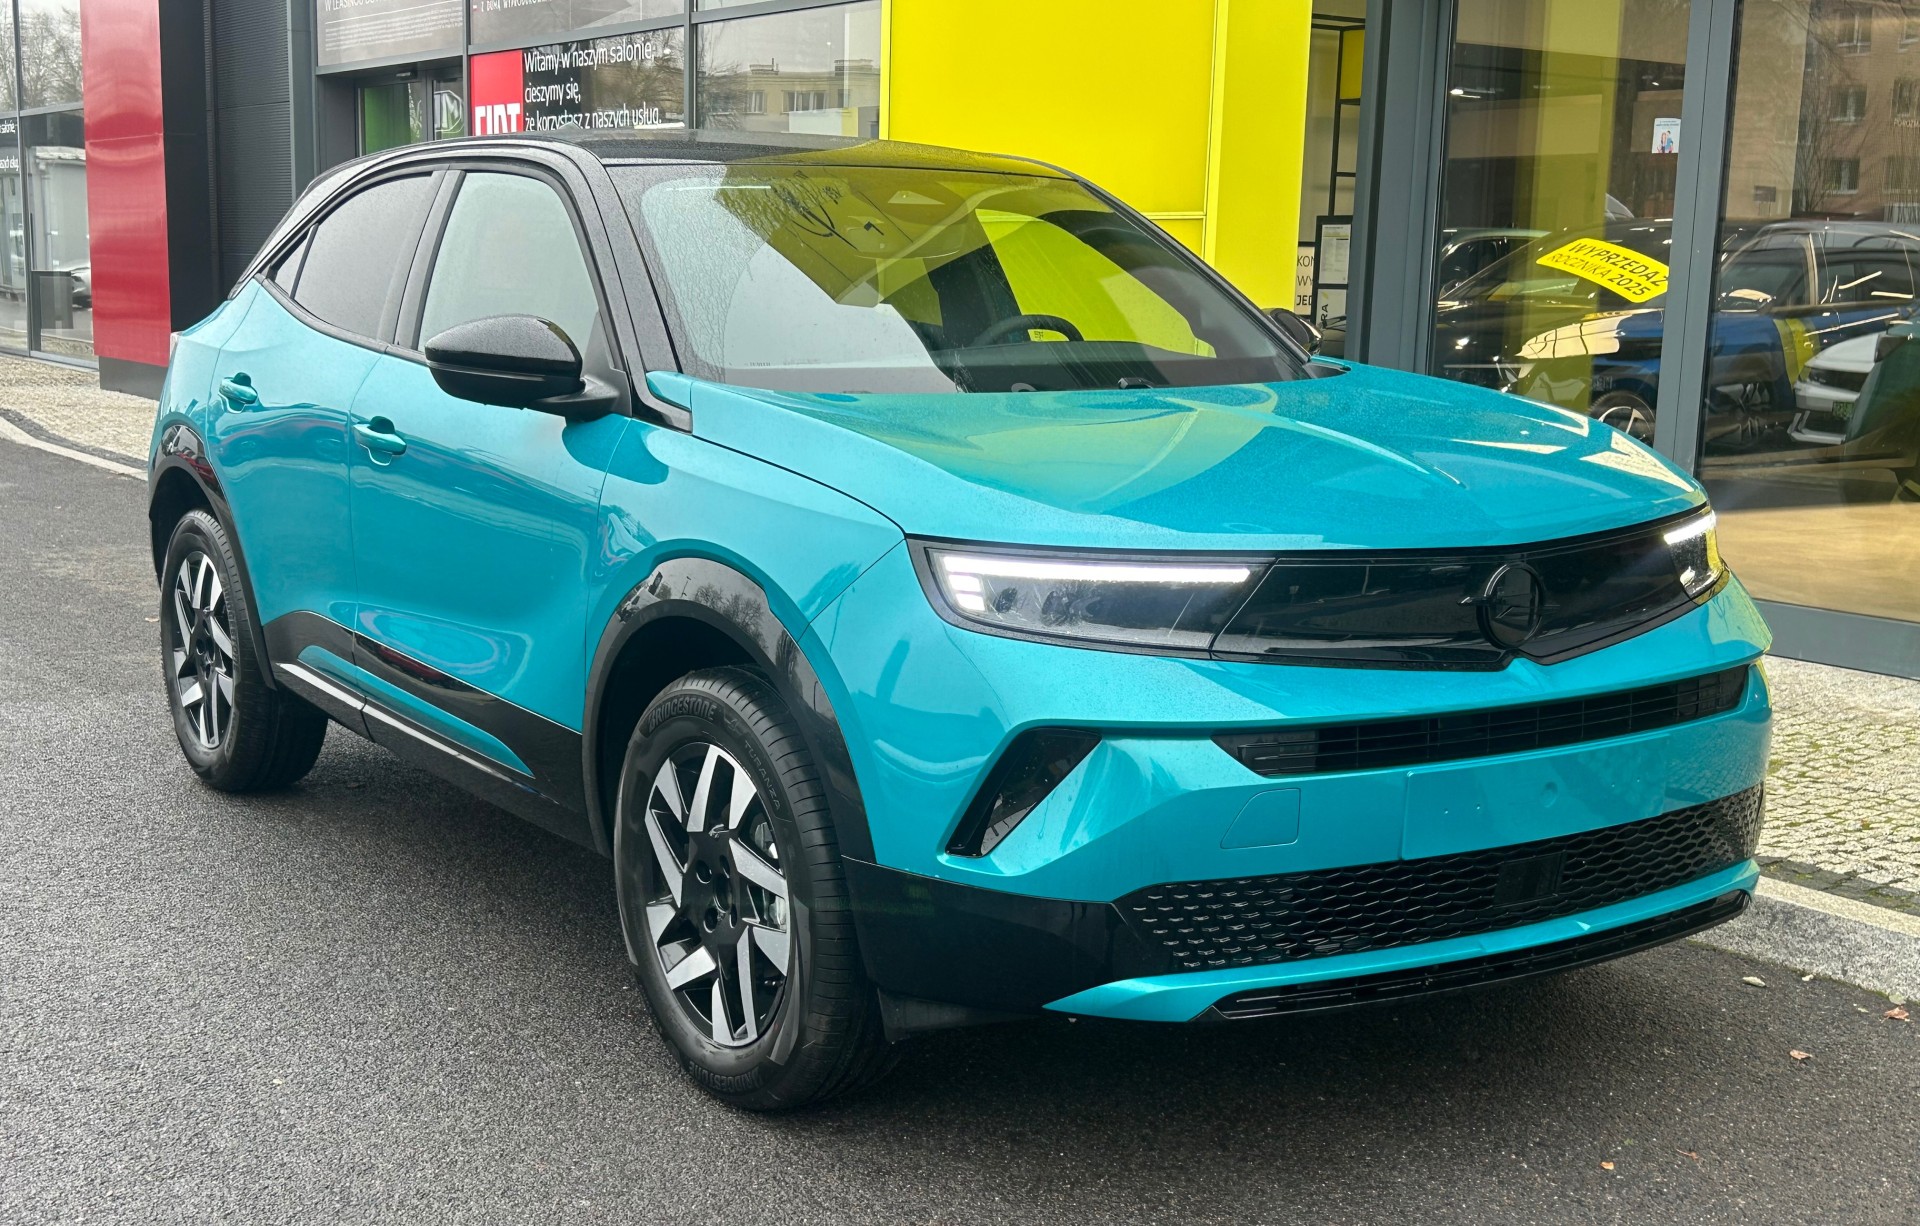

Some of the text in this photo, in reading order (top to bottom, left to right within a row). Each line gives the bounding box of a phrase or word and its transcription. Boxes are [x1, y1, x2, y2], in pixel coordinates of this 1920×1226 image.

[524, 37, 655, 75] Witamy w naszym salonie,
[524, 77, 581, 107] cieszymy się,
[475, 103, 521, 136] FIAT
[525, 113, 535, 132] że
[536, 109, 583, 132] korzystasz
[585, 112, 590, 130] z
[592, 103, 630, 129] naszych
[1546, 253, 1651, 296] ROCZNIKA 2025
[648, 696, 718, 733] BRIDGESTONE
[744, 739, 781, 811] TURANZA
